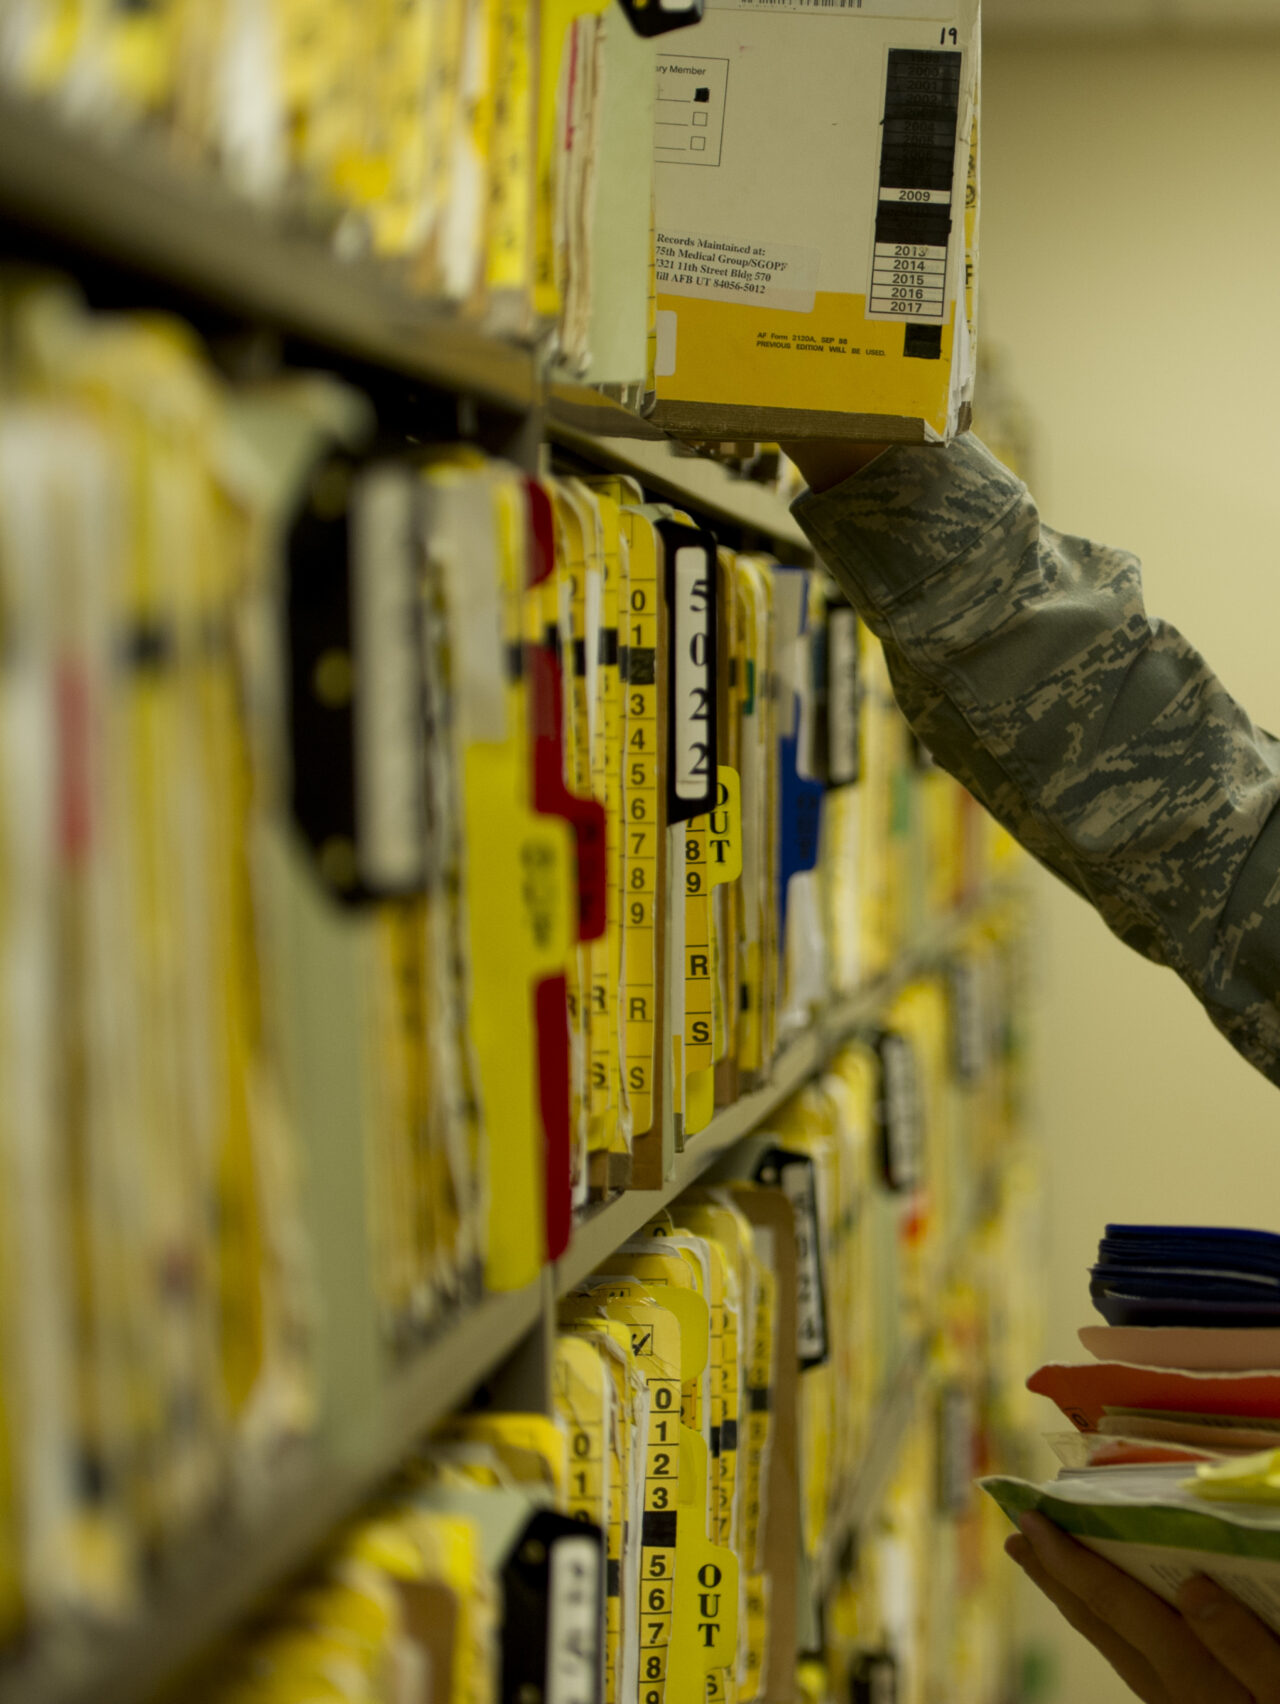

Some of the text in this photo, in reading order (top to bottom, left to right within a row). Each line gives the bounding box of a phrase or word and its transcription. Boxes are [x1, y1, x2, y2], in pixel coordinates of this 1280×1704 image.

[940, 27, 957, 45] 19
[670, 65, 705, 75] Member
[899, 190, 930, 202] 2009
[656, 246, 675, 257] 75th
[678, 248, 715, 262] Medical
[657, 233, 766, 256] Records Maintained at:
[895, 245, 927, 257] 2013
[678, 262, 697, 273] 11th
[700, 264, 728, 277] Street
[731, 267, 752, 281] Bldg
[755, 271, 771, 282] 570
[893, 260, 925, 271] 2014
[671, 273, 693, 284] AFB
[696, 276, 711, 287] UT
[713, 279, 766, 294] 84056-5012
[892, 273, 924, 285] 2015
[891, 287, 923, 299] 2016
[890, 301, 922, 313] 2017
[756, 340, 791, 349] PREVIOUS
[796, 343, 824, 352] EDITION
[829, 345, 847, 354] WILL
[851, 347, 860, 355] BE
[771, 332, 788, 341] Form
[821, 336, 834, 344] SEP
[631, 589, 646, 612] 0
[631, 623, 642, 646] 1
[630, 693, 645, 716] 3
[630, 728, 645, 750] 4
[631, 763, 645, 785] 5
[631, 798, 646, 820] 6
[631, 833, 646, 854] 7
[685, 839, 700, 861] 8
[631, 867, 646, 889] 8
[686, 872, 701, 893] 9
[630, 902, 644, 924] 9
[690, 954, 708, 976] R
[629, 997, 646, 1019] R
[692, 1021, 709, 1043] S
[629, 1066, 644, 1090] S
[655, 1388, 672, 1409] 0
[655, 1421, 668, 1442] 1
[653, 1453, 670, 1475] 2
[652, 1486, 668, 1509] 3
[649, 1554, 666, 1577] 5
[648, 1588, 665, 1611] 6
[697, 1563, 722, 1648] OUT
[648, 1622, 664, 1644] 7
[646, 1656, 661, 1679] 8
